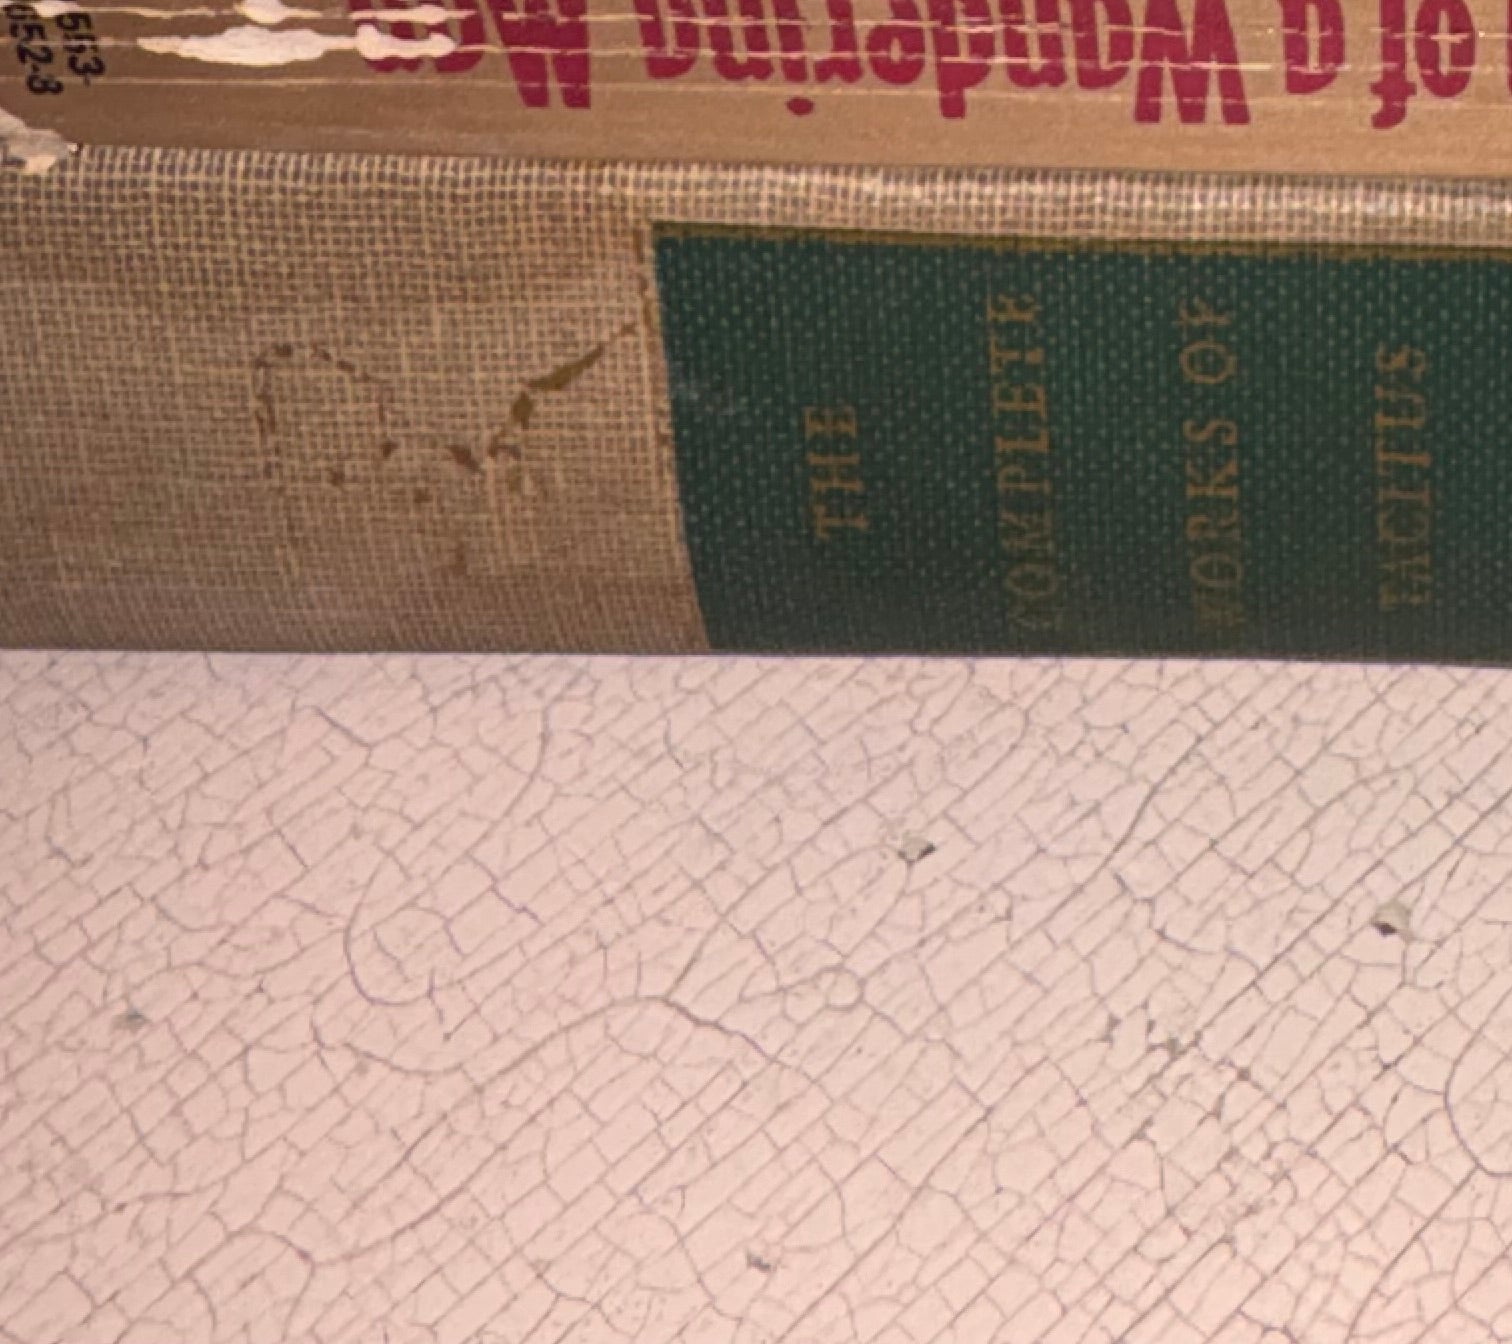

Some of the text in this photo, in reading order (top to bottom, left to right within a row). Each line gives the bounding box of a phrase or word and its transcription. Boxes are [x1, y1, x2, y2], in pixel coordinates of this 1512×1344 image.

[1177, 298, 1239, 385] OF
[804, 404, 873, 541] THE
[1371, 342, 1435, 614] TACITUS
